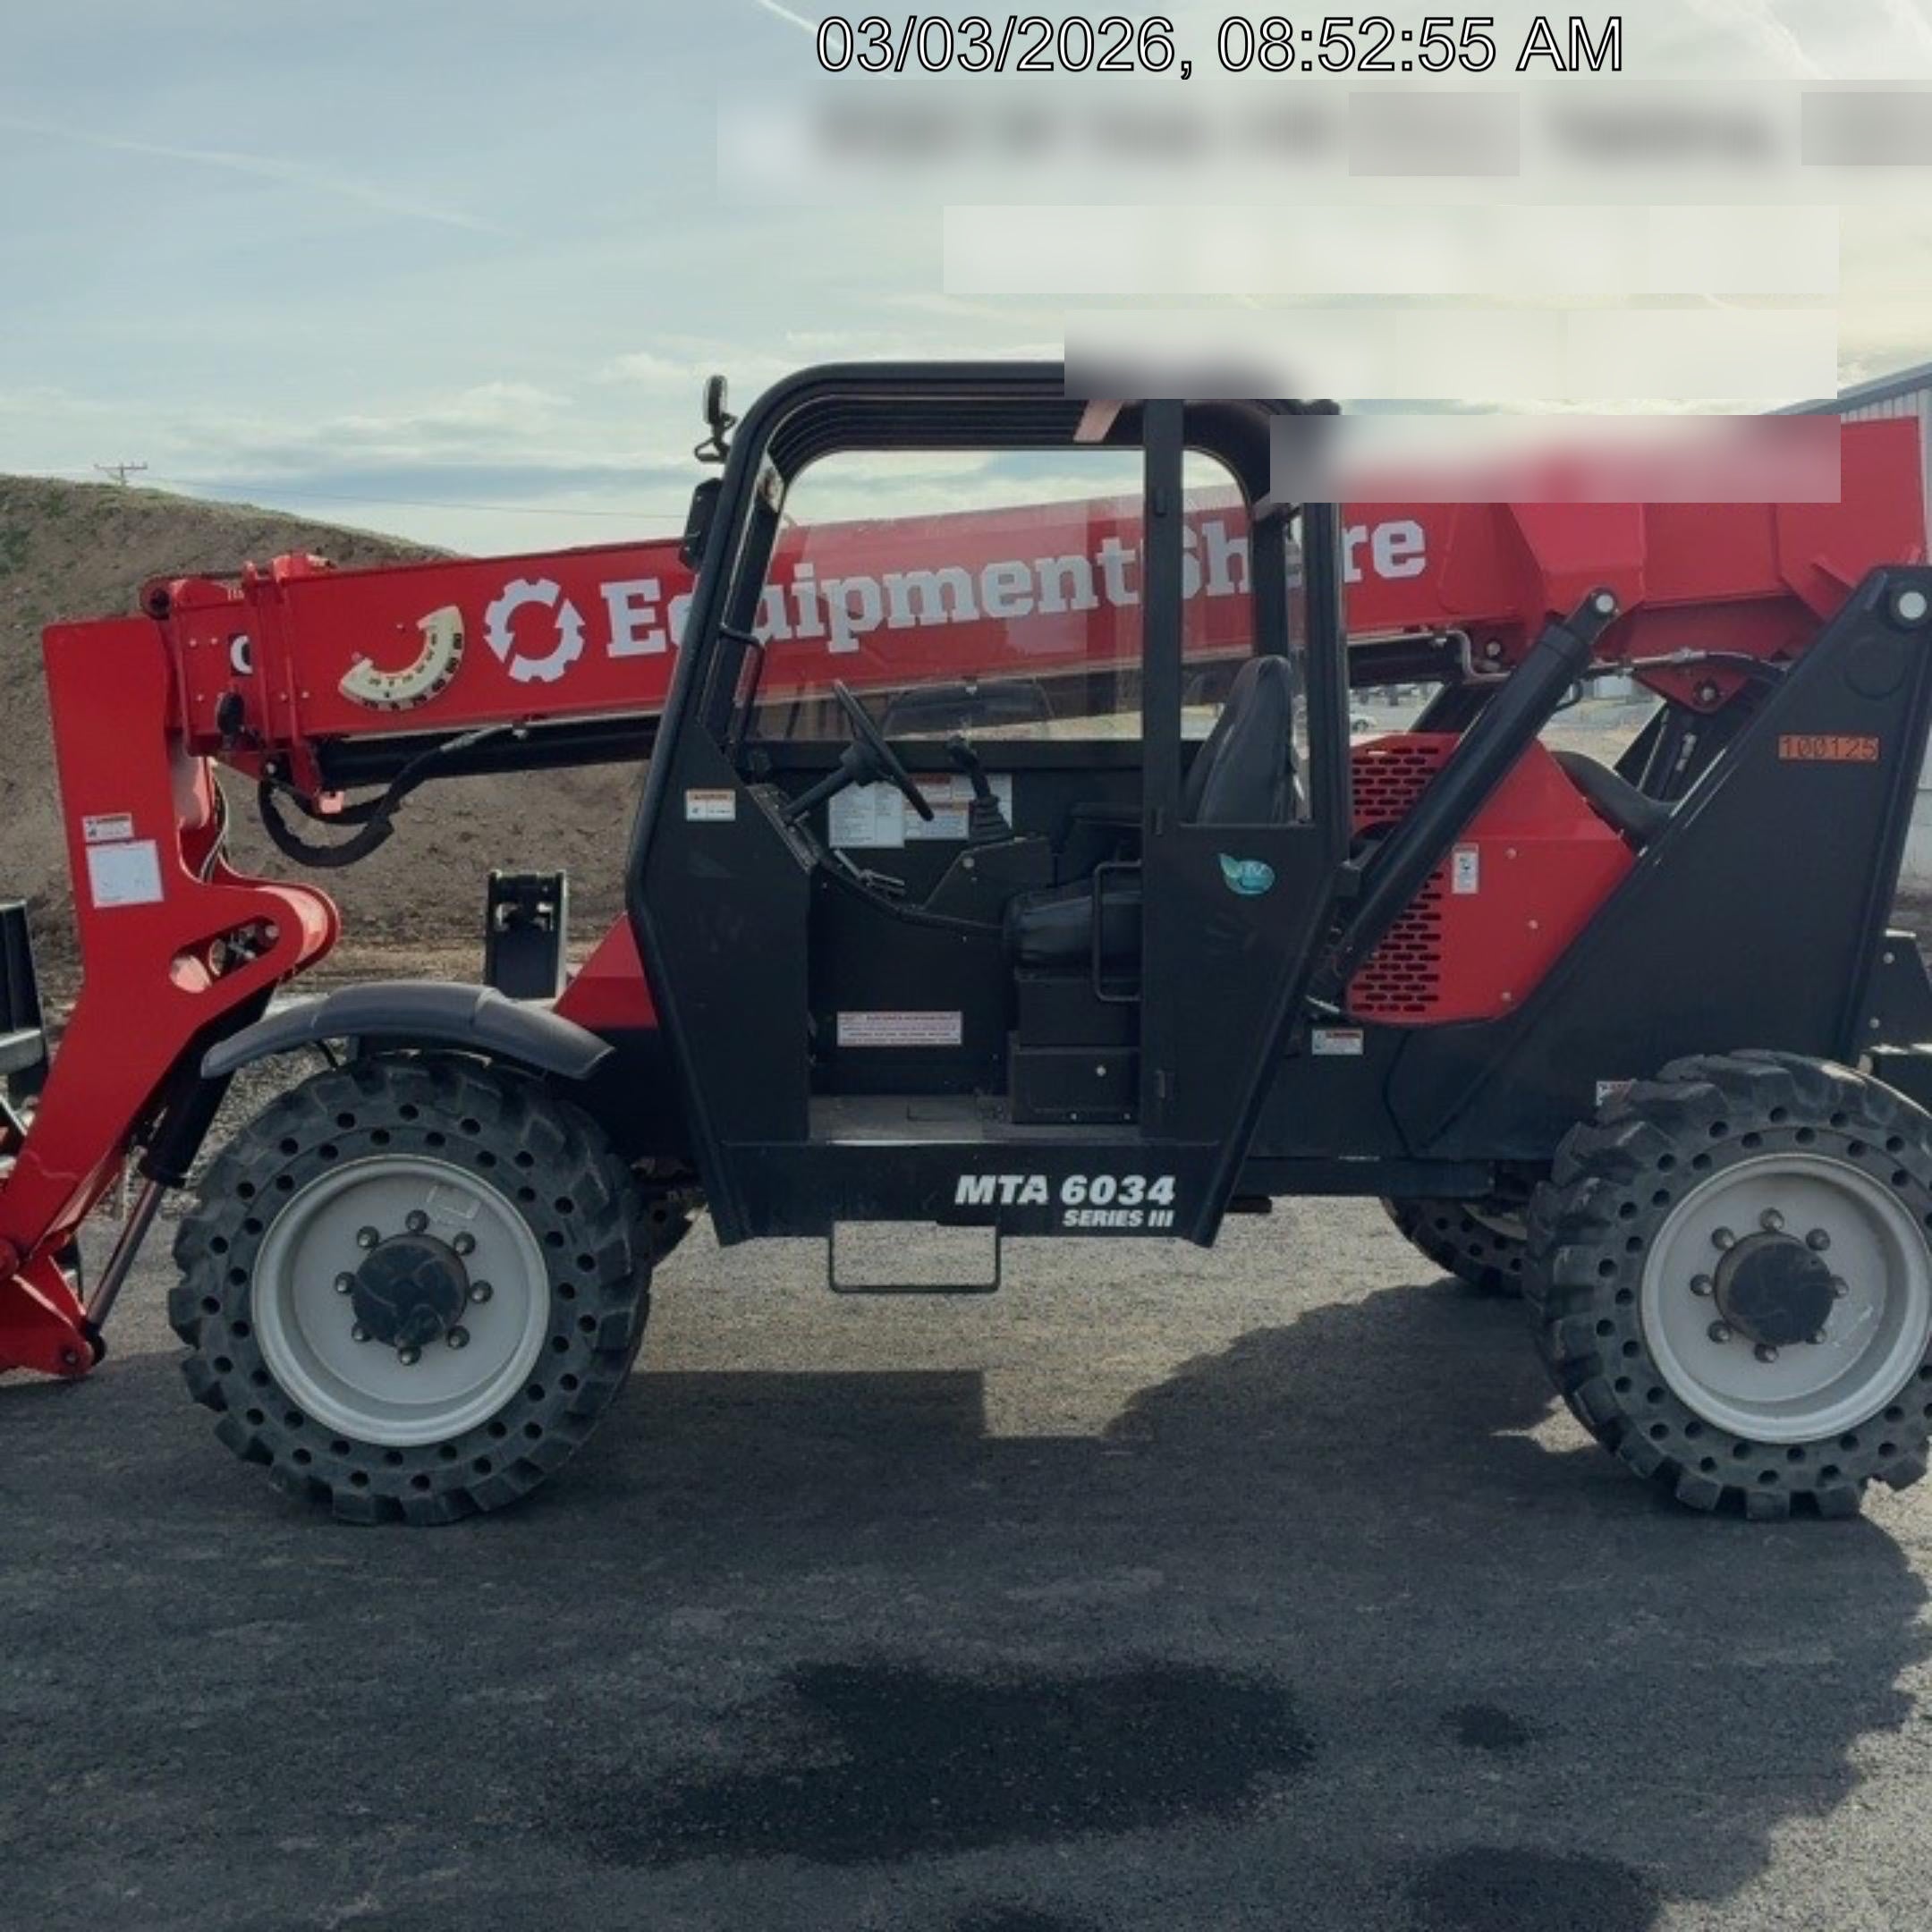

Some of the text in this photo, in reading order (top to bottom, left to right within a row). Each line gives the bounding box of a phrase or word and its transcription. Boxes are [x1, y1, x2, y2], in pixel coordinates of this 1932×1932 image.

[954, 1174, 1176, 1206] MTA 6034
[1063, 1209, 1174, 1227] SERIES III
